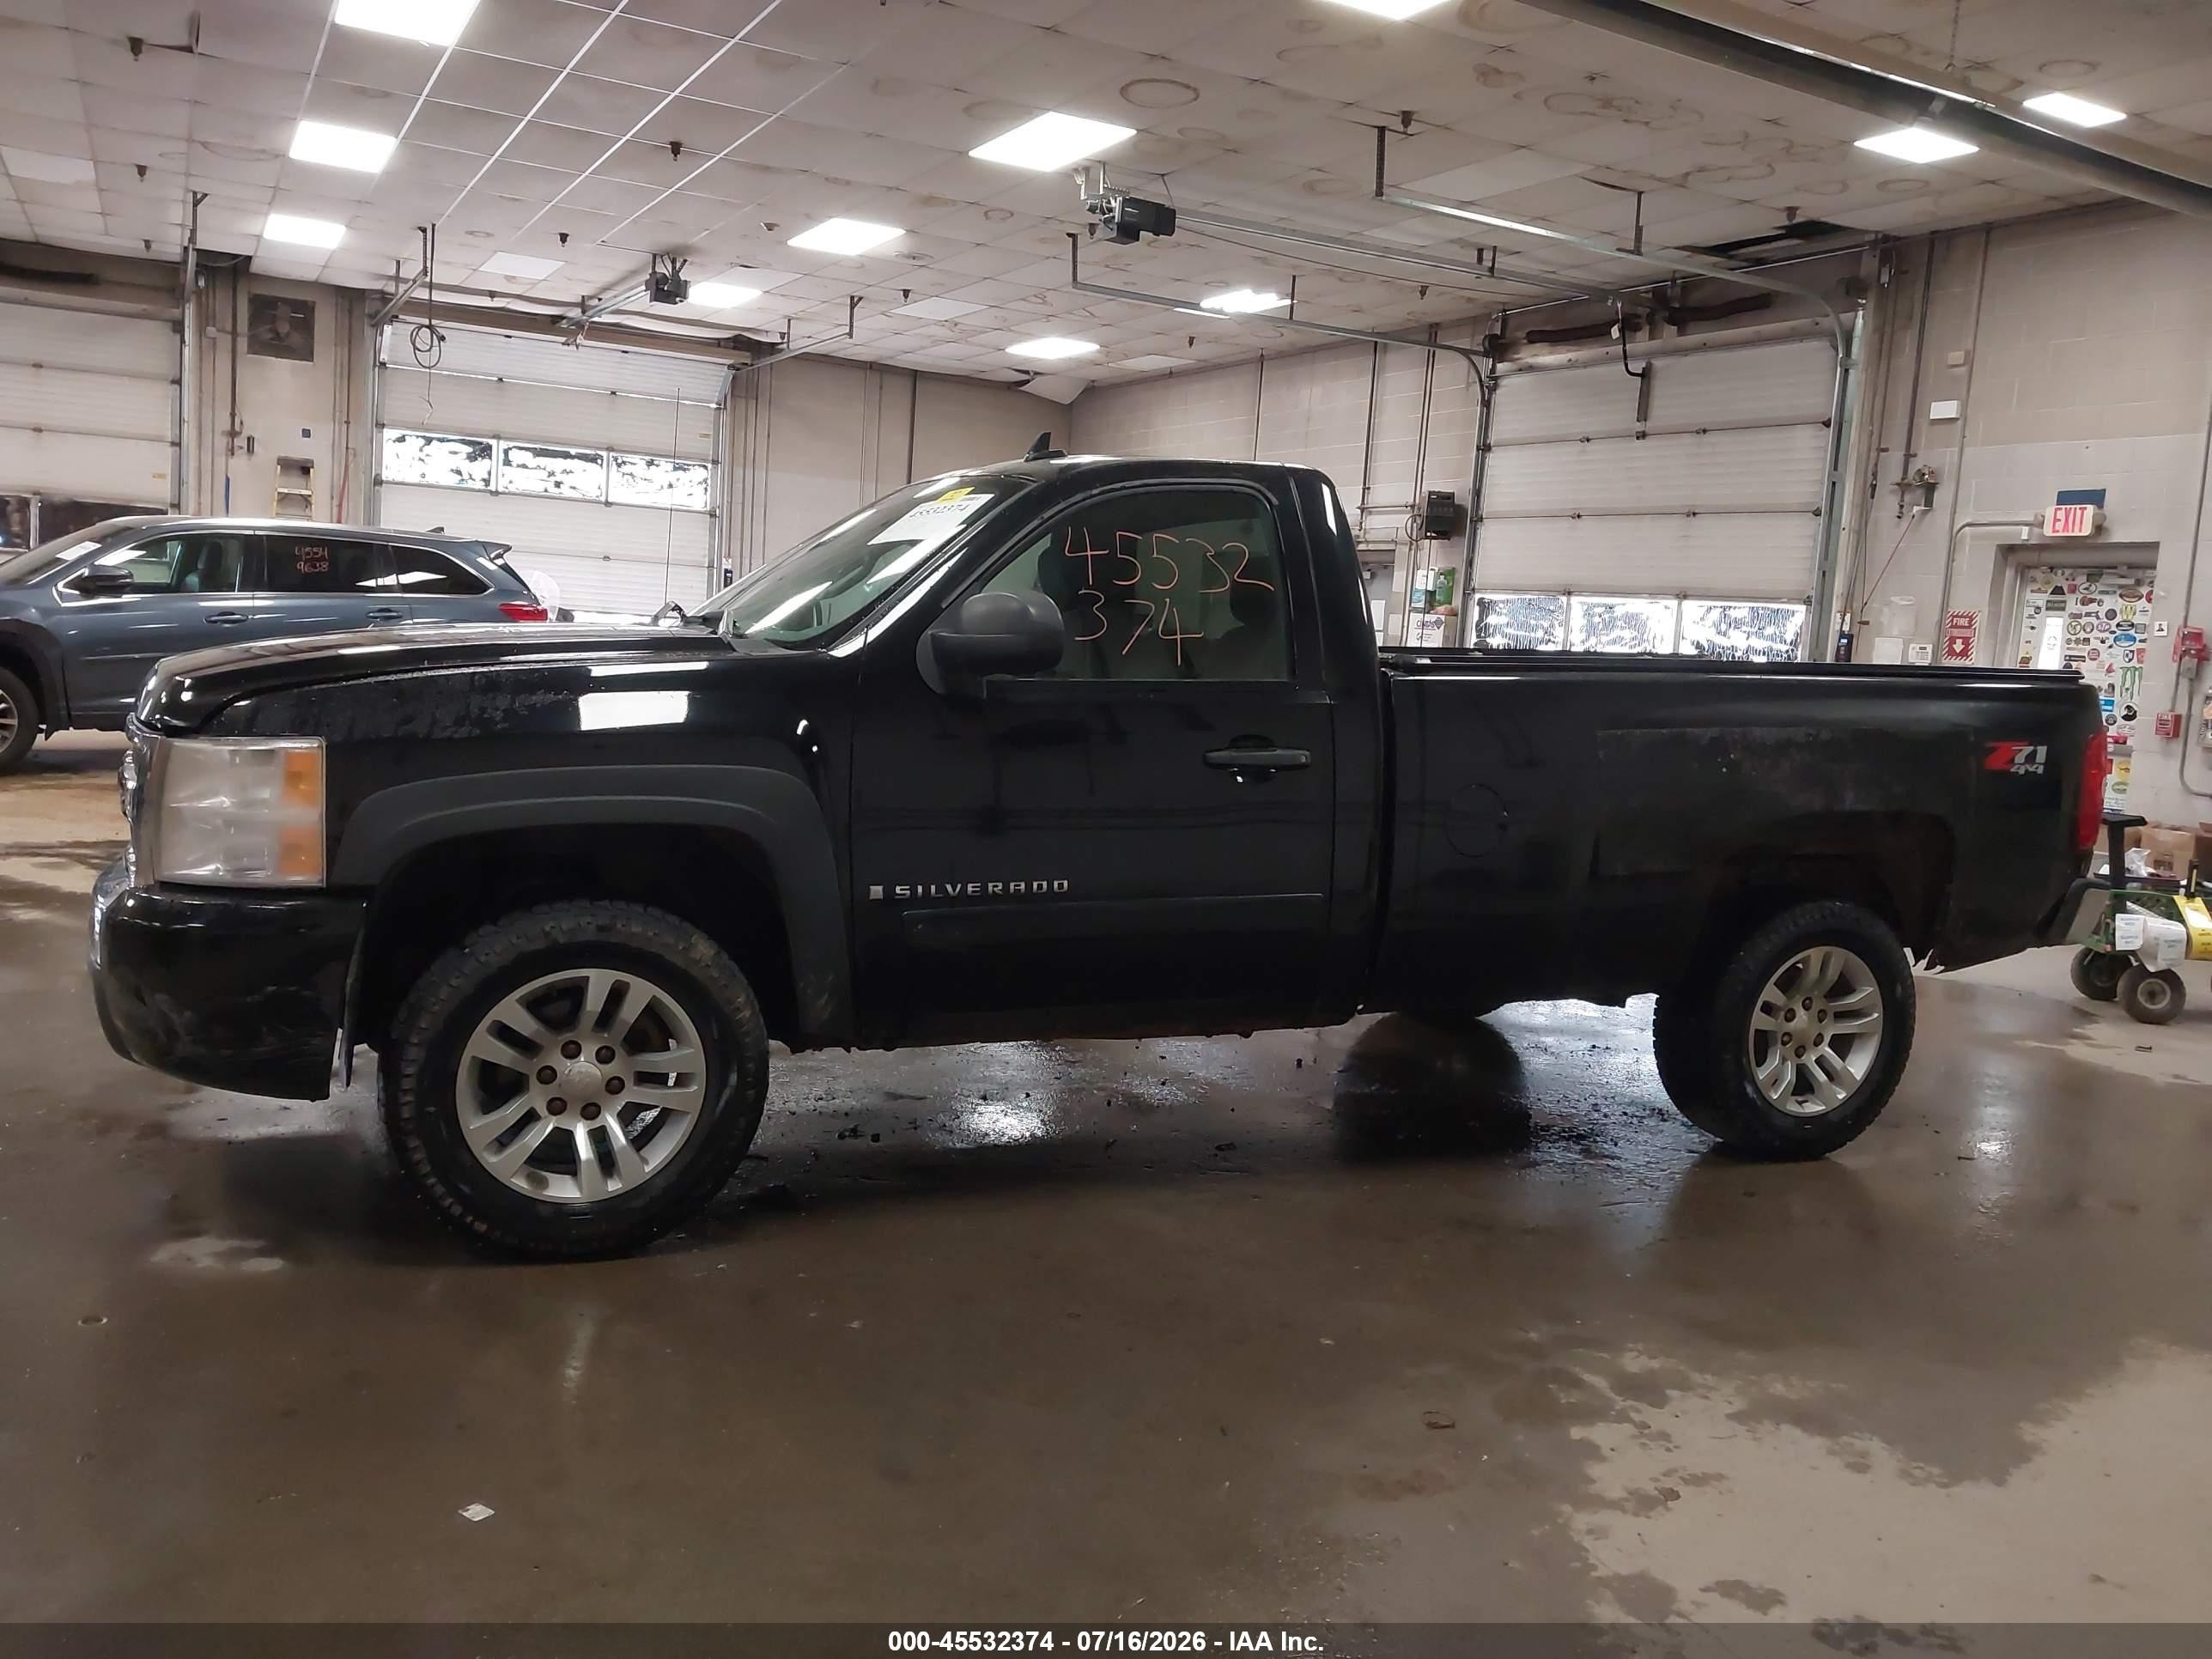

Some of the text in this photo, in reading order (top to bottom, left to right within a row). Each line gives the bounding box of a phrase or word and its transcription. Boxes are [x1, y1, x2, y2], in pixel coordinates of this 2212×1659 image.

[2051, 507, 2087, 533] EXIT
[295, 545, 329, 561] 4554
[1065, 526, 1274, 592] 45532
[1073, 586, 1204, 666] 374
[1953, 617, 1970, 626] FIRE
[1984, 741, 2048, 769] Z71
[894, 879, 1068, 899] SILVERADO
